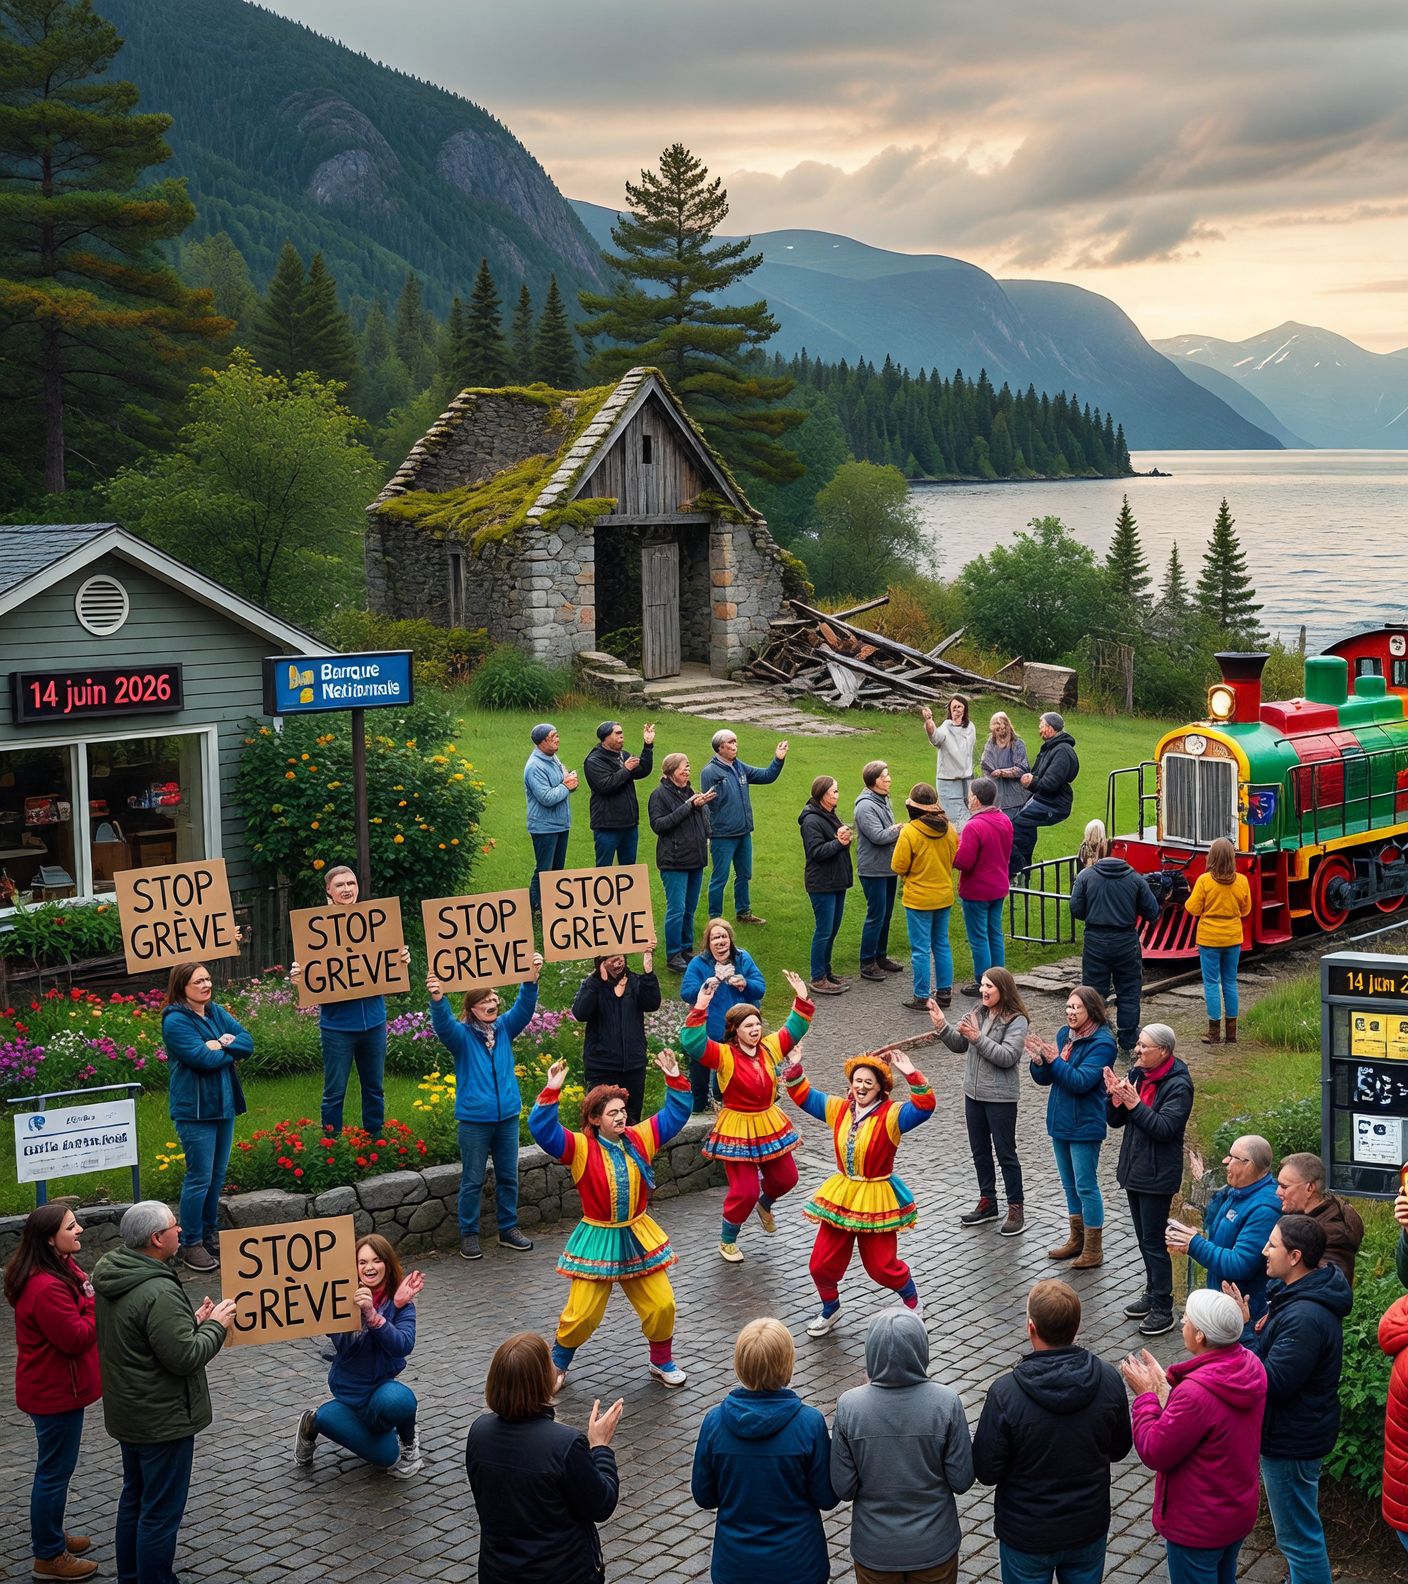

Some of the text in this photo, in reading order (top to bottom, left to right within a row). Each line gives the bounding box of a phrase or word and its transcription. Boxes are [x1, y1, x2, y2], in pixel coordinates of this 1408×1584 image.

[30, 673, 171, 714] 14 juin 2026
[133, 869, 213, 914] STOP
[554, 873, 634, 910] STOP
[130, 910, 231, 960] GRÈVE
[307, 908, 387, 951] STOP
[437, 899, 517, 940] STOP
[549, 909, 649, 950] GRÈVE
[304, 948, 402, 993] GRÈVE
[433, 937, 531, 982] GRÈVE
[1346, 971, 1364, 991] 14
[238, 1229, 337, 1279] STOP
[233, 1276, 351, 1332] GRÈVE
